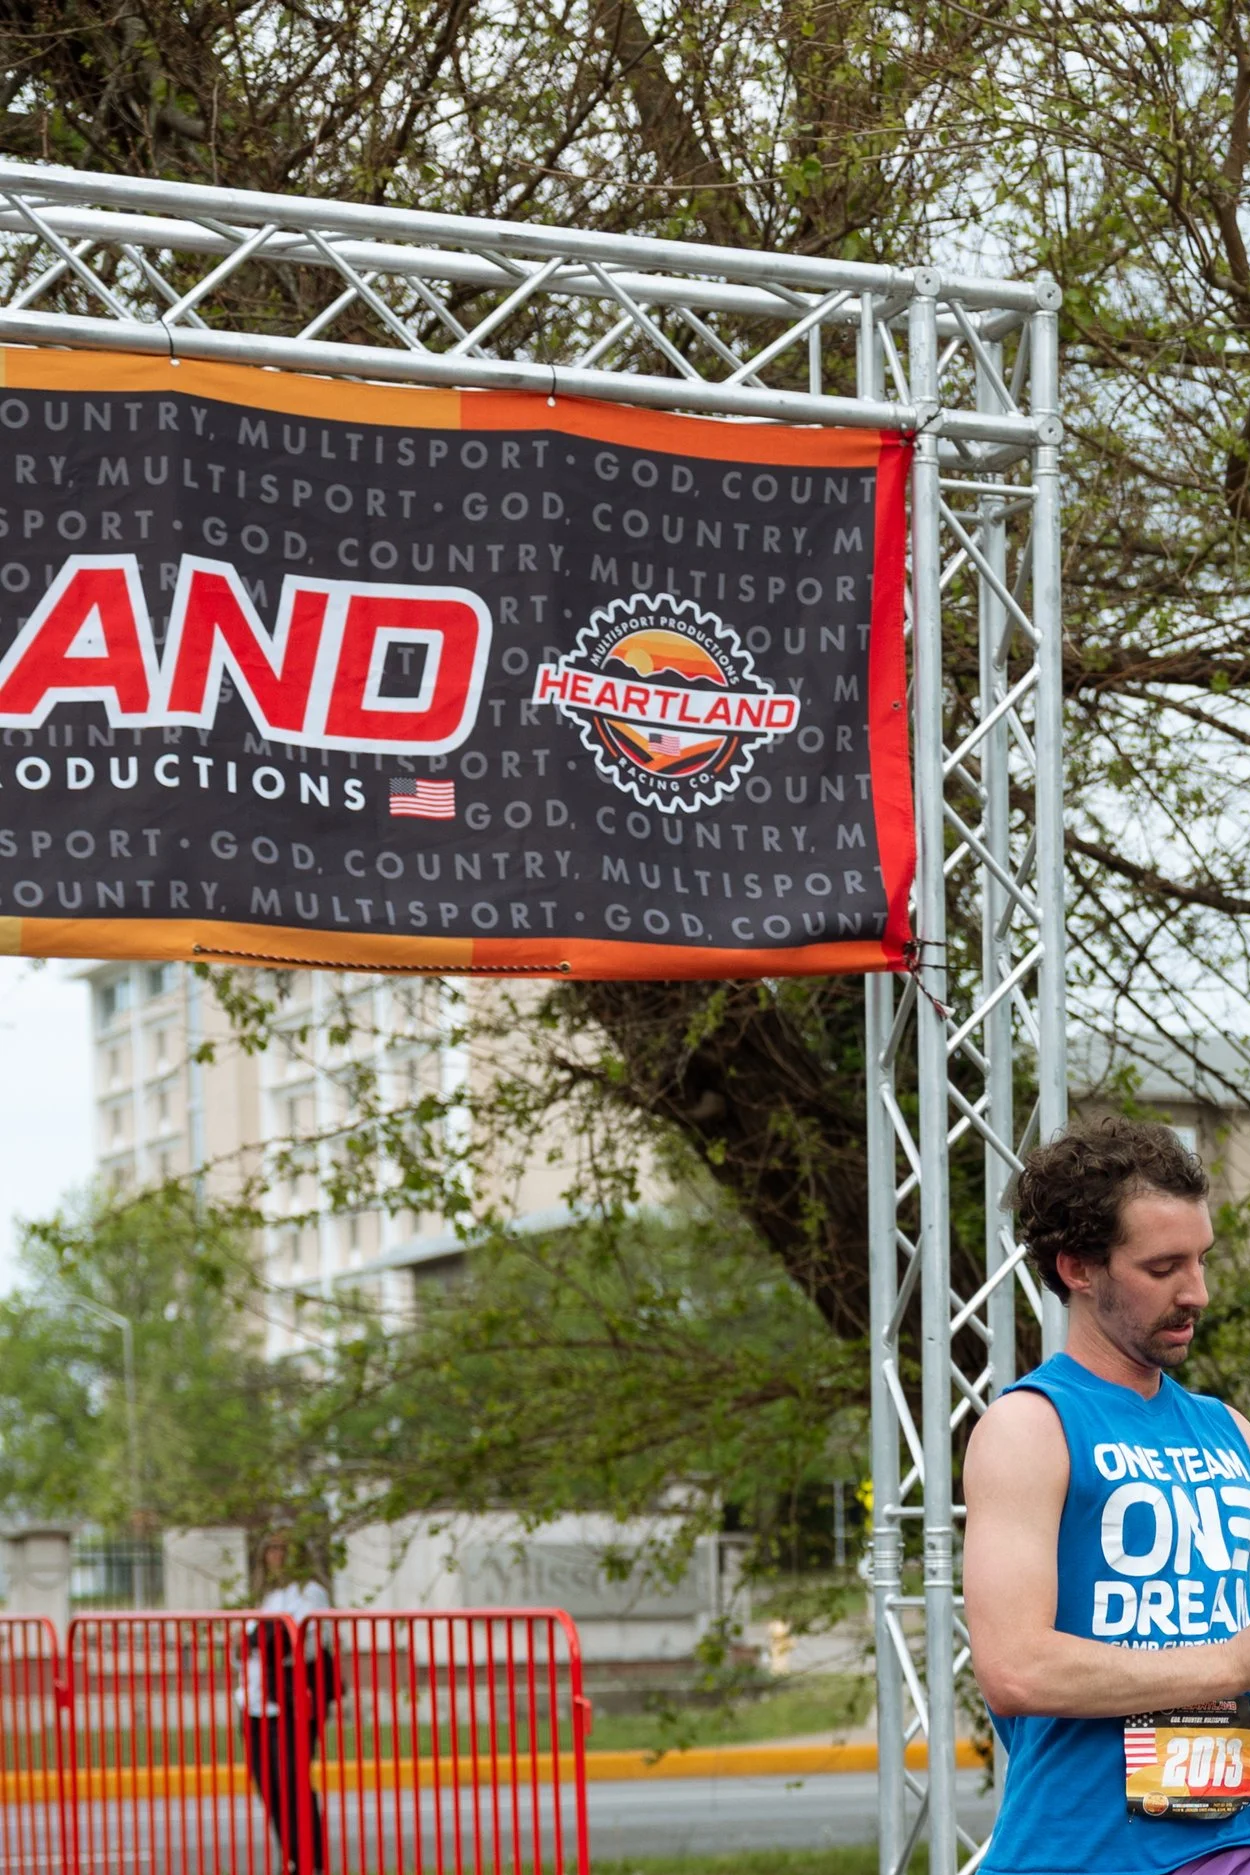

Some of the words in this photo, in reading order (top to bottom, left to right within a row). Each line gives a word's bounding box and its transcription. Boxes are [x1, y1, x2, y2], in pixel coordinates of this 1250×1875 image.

[238, 416, 549, 469] MULTISPORT
[594, 451, 700, 498] GOD,
[98, 455, 416, 519] MULTISPORT
[463, 491, 570, 526] GOD,
[592, 502, 812, 557] COUNTRY,
[202, 516, 314, 565] GOD,
[338, 537, 570, 577] COUNTRY,
[590, 555, 874, 605] MULTISPOR
[0, 553, 493, 757] AND
[589, 615, 655, 667] MULTISPORT
[659, 617, 740, 685] PRODUCTIONS
[723, 624, 871, 655] OUNT
[537, 668, 797, 729] HEARTLAND
[0, 753, 366, 811] ODUCTIONS
[617, 756, 681, 792] RACING
[688, 773, 716, 790] CO.
[210, 830, 324, 876] GOD,
[344, 849, 580, 881] COUNTRY,
[465, 799, 576, 832] GOD,
[596, 806, 816, 854] COUNTRY,
[3, 879, 227, 914] OUNTRY,
[250, 886, 558, 930] MULTISPORT
[604, 902, 713, 942] GOD,
[1094, 1443, 1172, 1481] ONE
[1161, 1736, 1243, 1788] 2013
